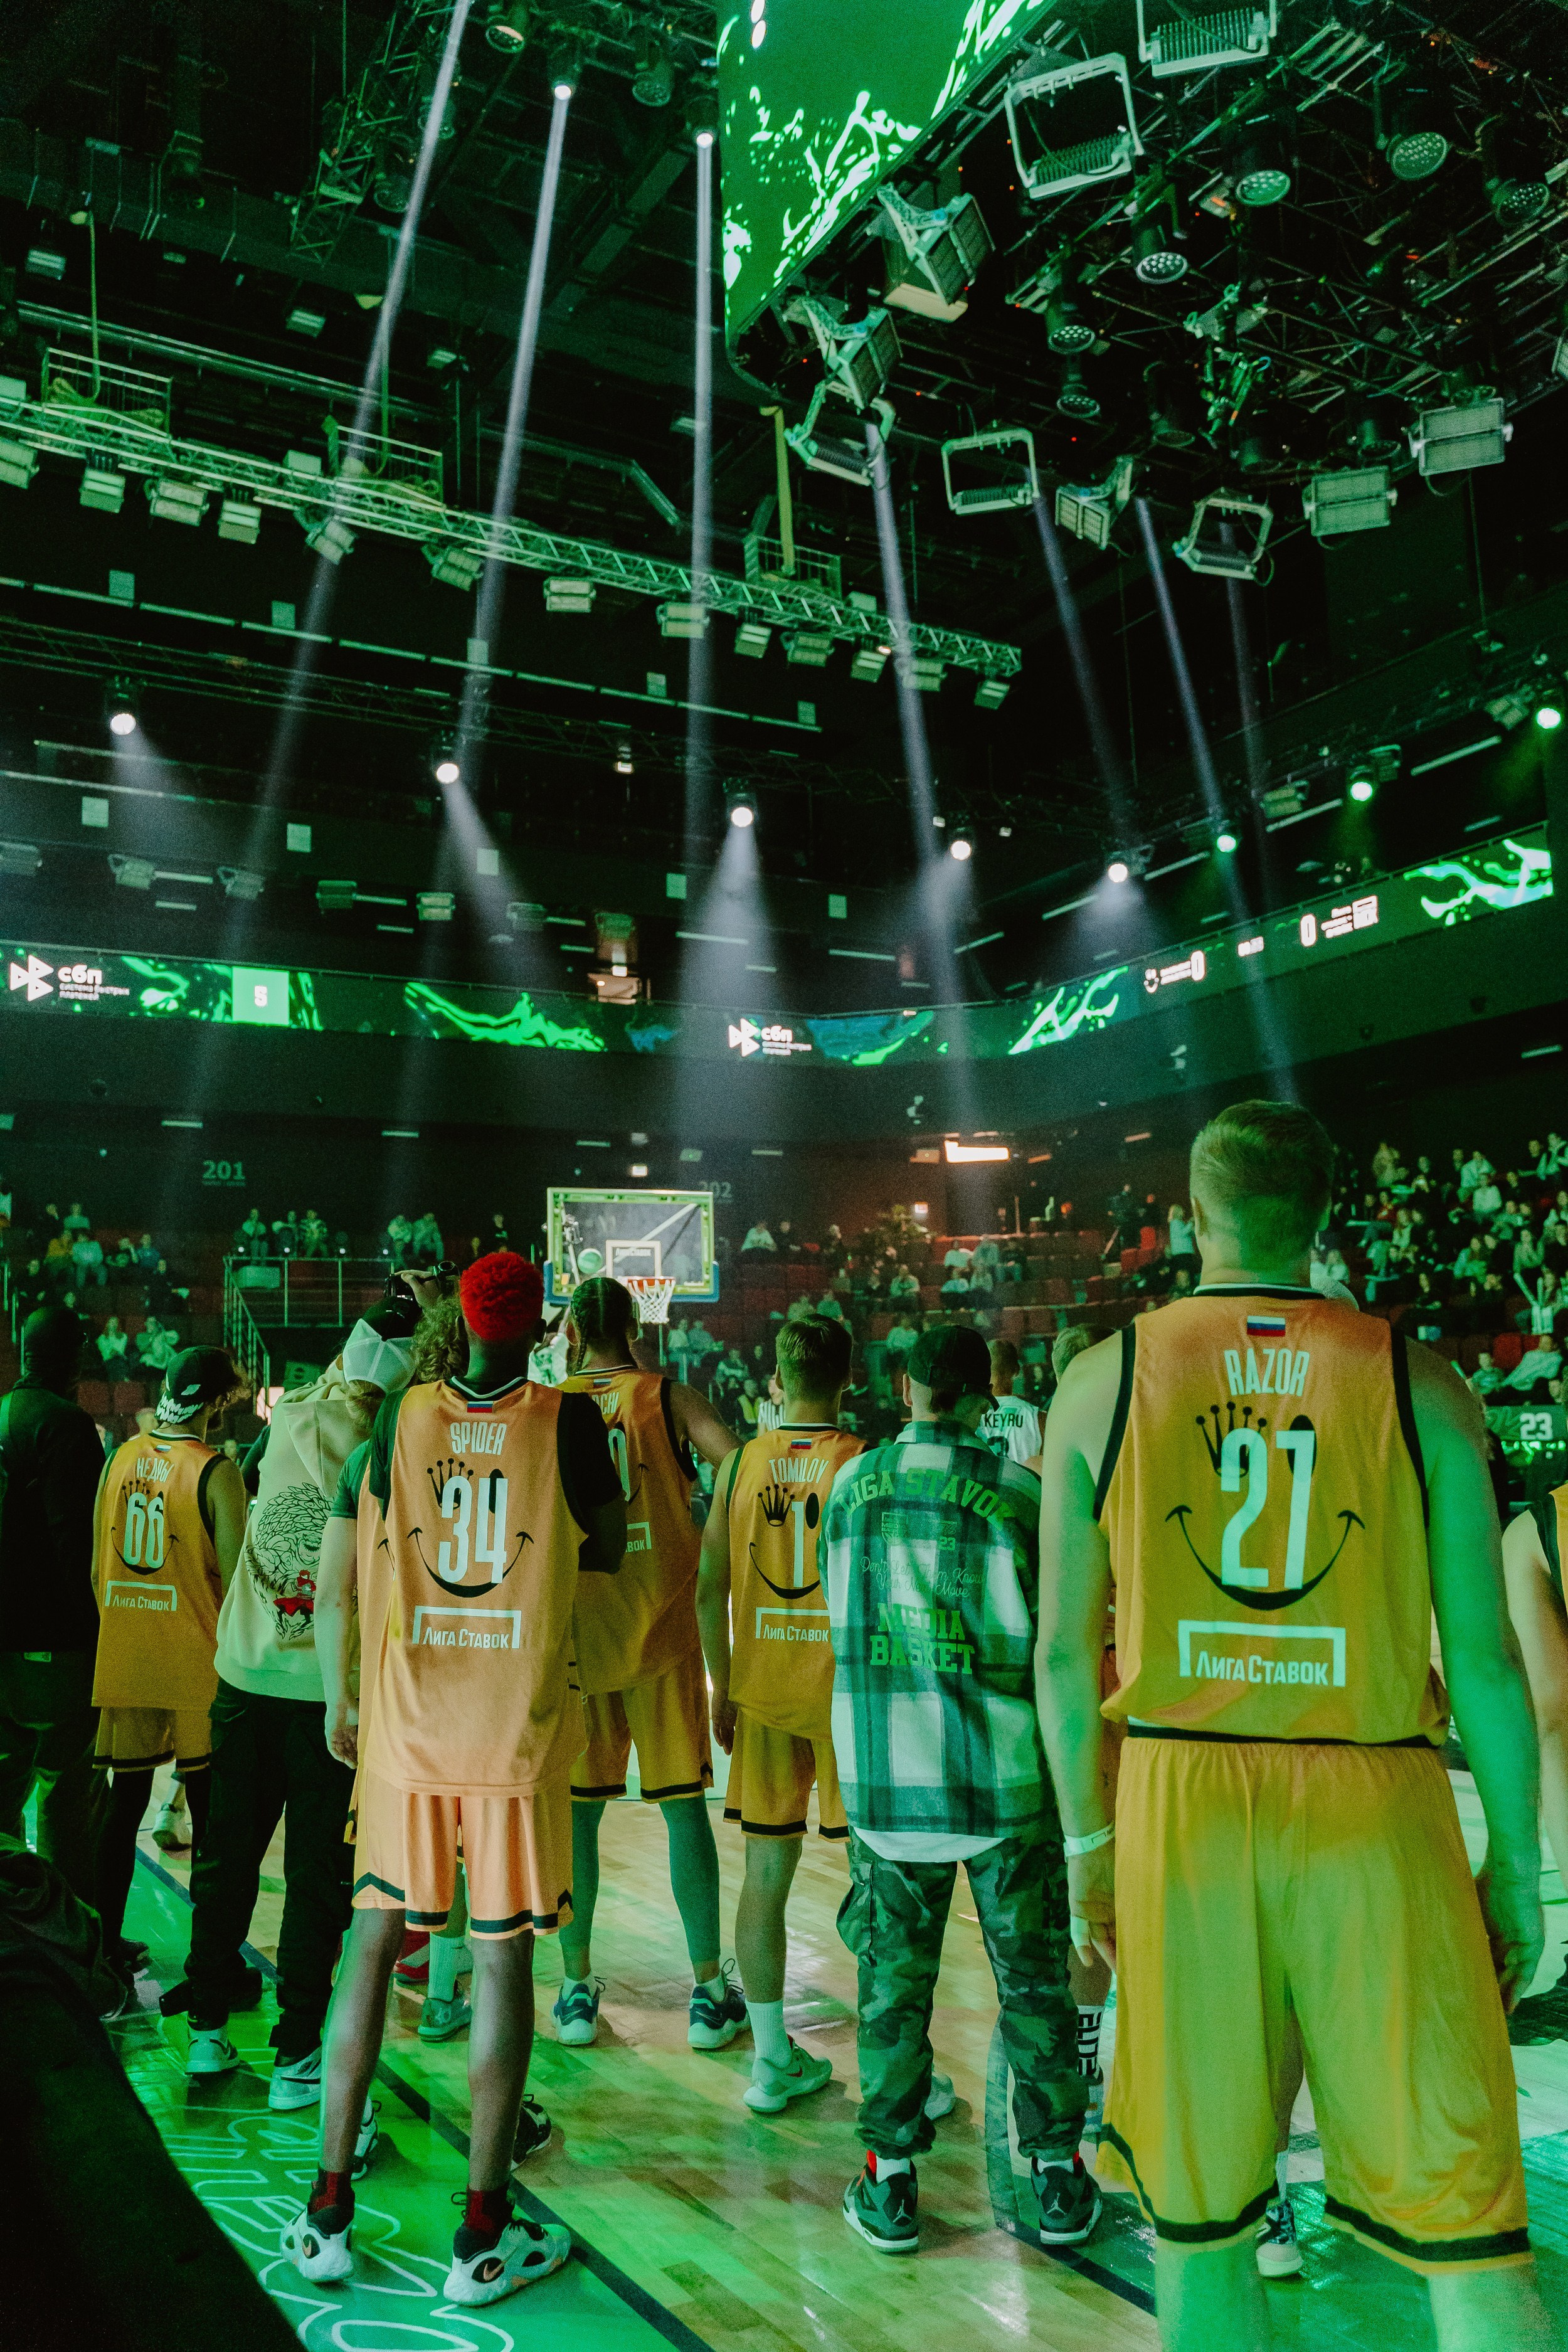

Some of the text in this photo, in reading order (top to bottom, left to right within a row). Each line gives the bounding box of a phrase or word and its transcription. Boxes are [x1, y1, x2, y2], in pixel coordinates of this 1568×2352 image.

[203, 1160, 245, 1180] 201
[1224, 1348, 1310, 1397] RAZOR
[983, 1413, 1024, 1428] KEYRU
[1520, 1412, 1554, 1440] 23
[450, 1422, 507, 1455] SPIDER
[136, 1458, 174, 1483] НЕДРЫ
[768, 1458, 829, 1484] TOMILOV
[835, 1468, 1015, 1531] LIGA STAVOK
[1221, 1428, 1315, 1589] 27
[124, 1492, 164, 1568] 66
[438, 1475, 508, 1584] 34
[792, 1502, 804, 1587] 1
[939, 1536, 955, 1550] 23
[860, 1556, 887, 1572] Don't
[935, 1581, 970, 1598] Move
[877, 1602, 965, 1641] MEDIA
[870, 1635, 975, 1675] BASKET
